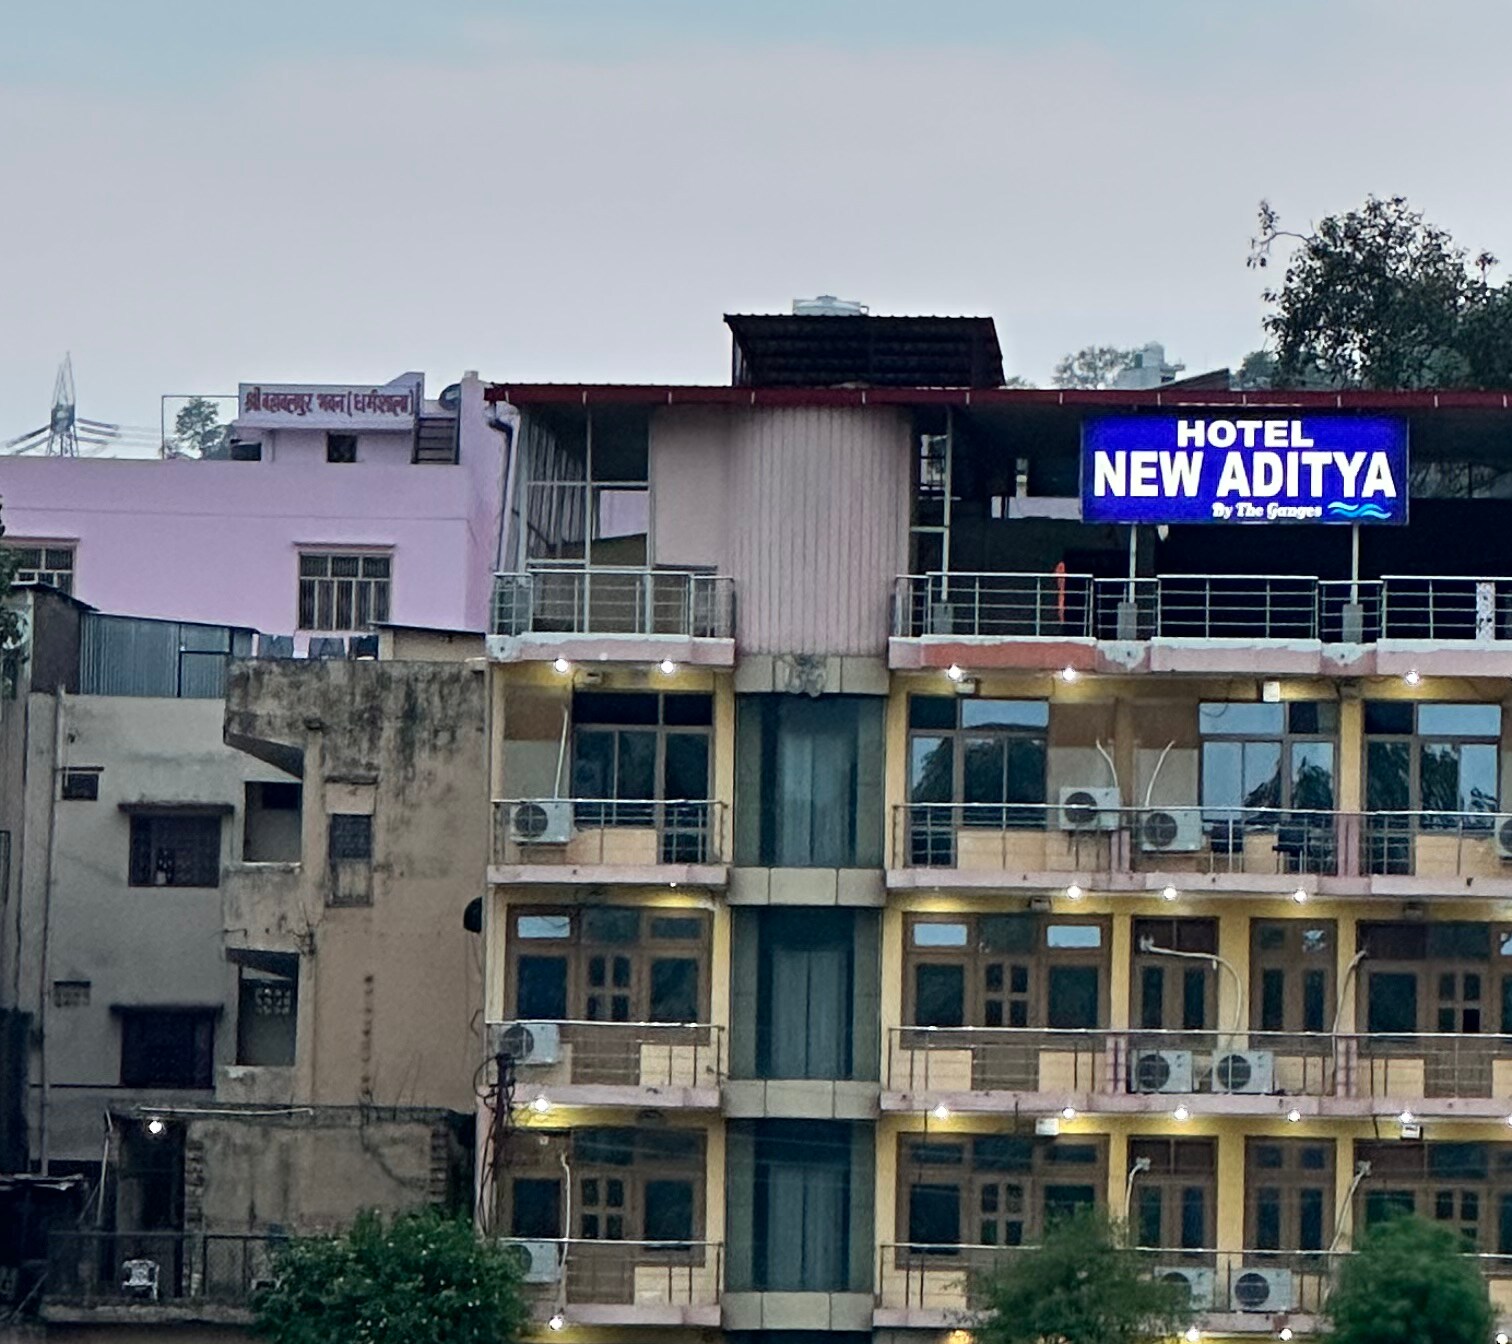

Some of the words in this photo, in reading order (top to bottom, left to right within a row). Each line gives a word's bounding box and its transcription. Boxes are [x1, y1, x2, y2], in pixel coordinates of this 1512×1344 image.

[1177, 420, 1314, 448] HOTEL
[1094, 451, 1204, 497] NEW
[1216, 451, 1397, 498] ADITYA
[1212, 502, 1233, 520] By
[1236, 502, 1263, 518] The
[1267, 502, 1322, 520] Ganges
